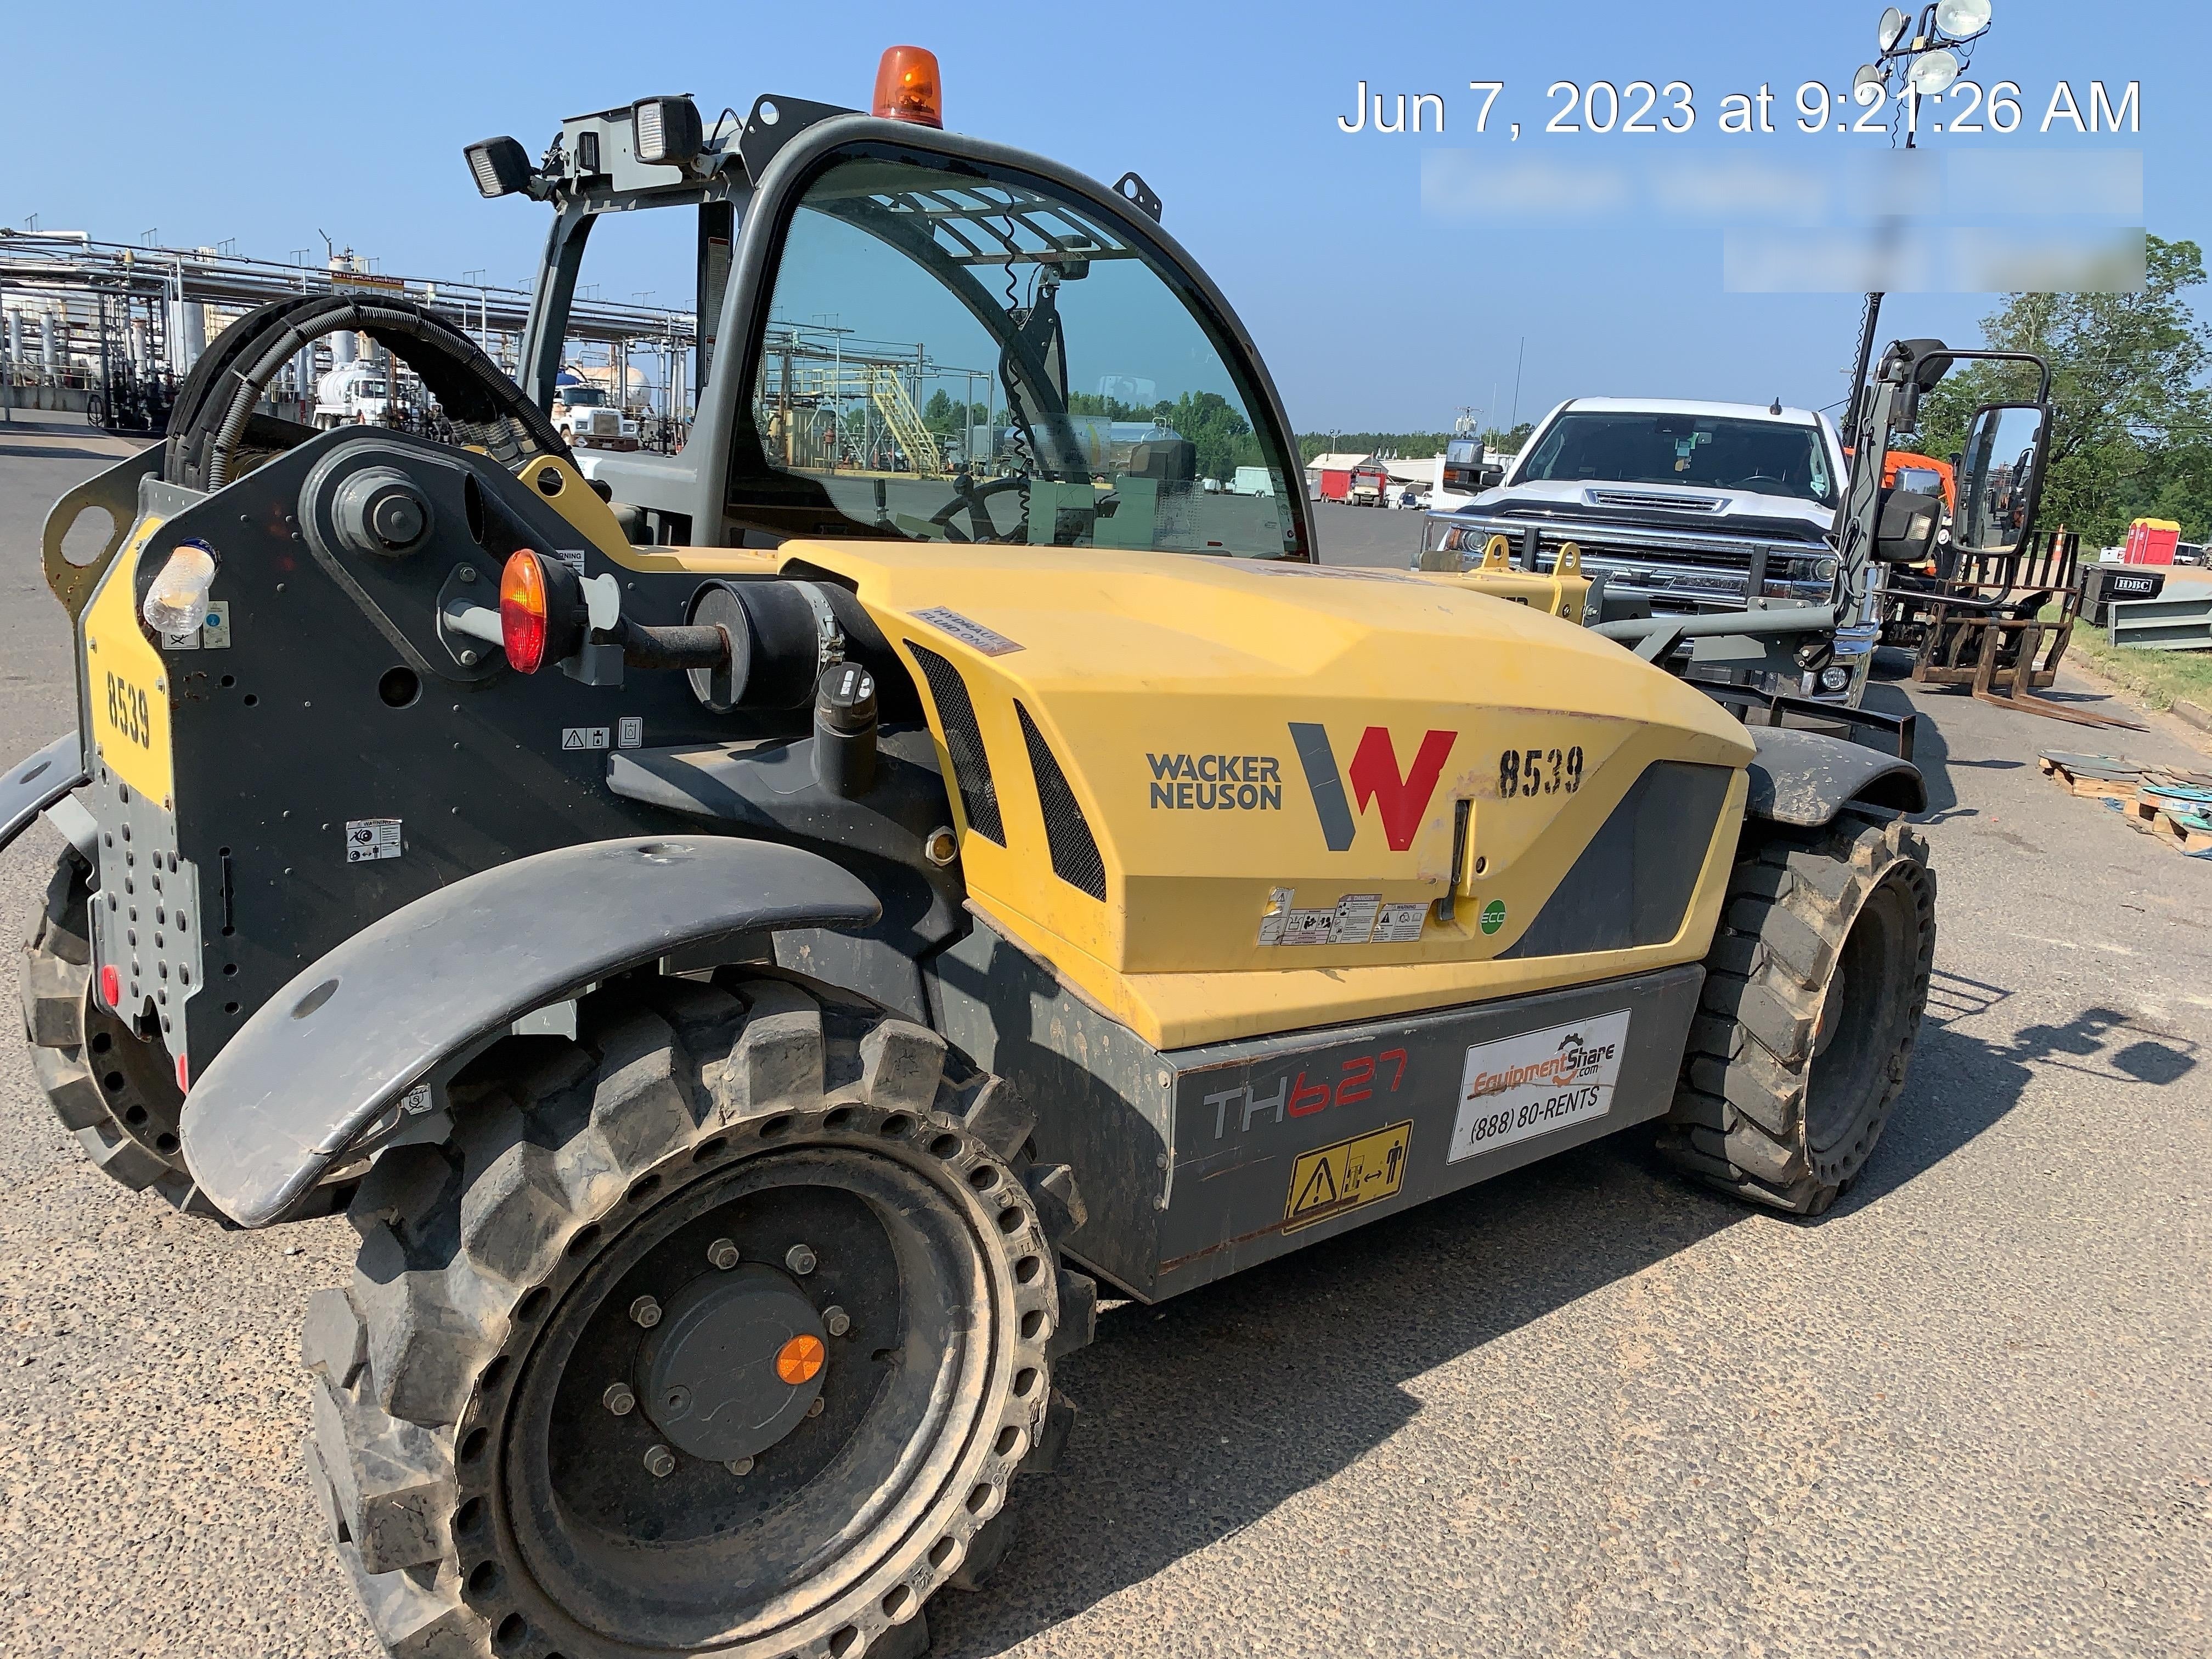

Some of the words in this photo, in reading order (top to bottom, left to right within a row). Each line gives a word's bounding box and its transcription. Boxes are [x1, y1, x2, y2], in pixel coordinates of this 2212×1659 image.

[918, 612, 960, 633] FLUID
[107, 671, 149, 750] 8539
[1146, 753, 1282, 783] WACKER
[1500, 745, 1584, 799] 8539
[1150, 782, 1282, 810] NEUSON
[1481, 912, 1505, 923] ECO
[1204, 1048, 1408, 1139] TH627
[1471, 1108, 1514, 1144] (888)
[1517, 1085, 1600, 1128] 80-RENTS
